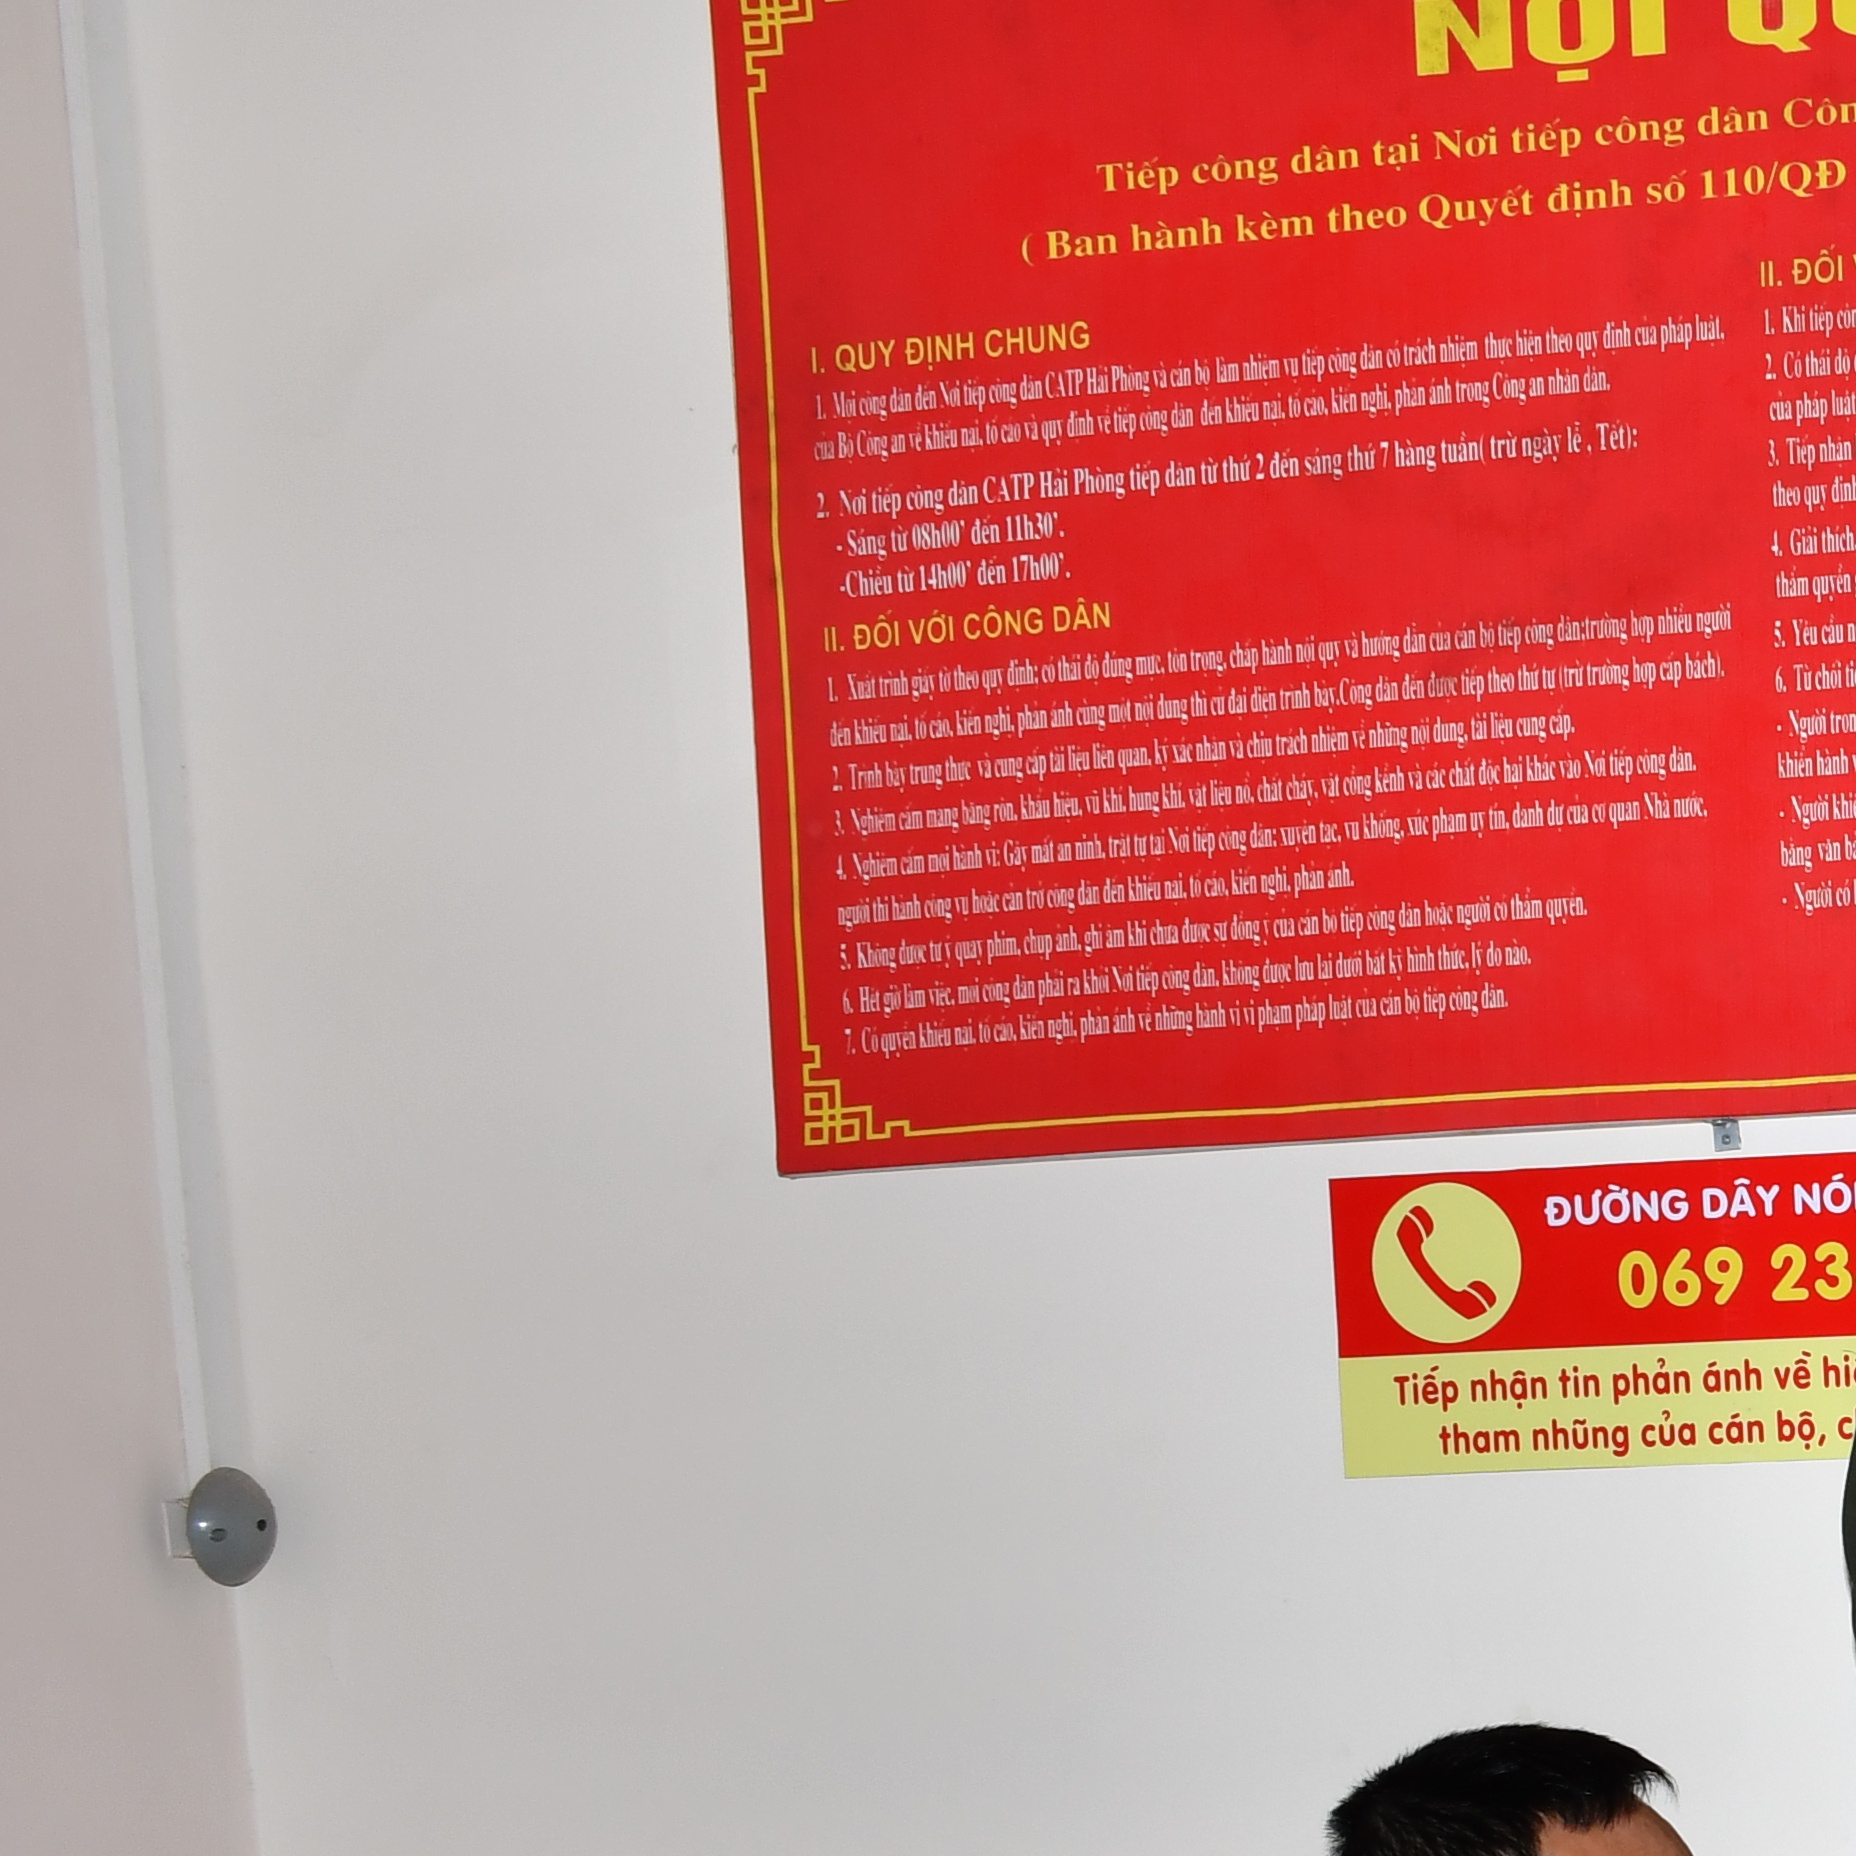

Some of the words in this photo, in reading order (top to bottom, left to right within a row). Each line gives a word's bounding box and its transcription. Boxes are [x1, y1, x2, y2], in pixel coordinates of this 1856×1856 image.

[1096, 156, 1179, 196] Tiếp
[1192, 154, 1279, 186] công
[1290, 144, 1359, 175] dân
[1372, 132, 1420, 172] tại
[1433, 125, 1498, 161] Nơi
[1511, 114, 1582, 158] tiếp
[1594, 115, 1685, 148] công
[1697, 105, 1769, 137] dân
[1046, 229, 1118, 260] Ban
[1131, 216, 1223, 252] hành
[1236, 210, 1314, 243] kèm
[1327, 202, 1407, 234] theo
[1418, 186, 1533, 230] Quyết
[1547, 178, 1633, 219] định
[1646, 170, 1686, 205] số
[1702, 158, 1847, 200] 110/QĐ
[1760, 260, 1783, 288] II.
[1791, 248, 1844, 286] ĐỐI
[811, 346, 825, 374] I.
[835, 338, 896, 374] QUY
[904, 331, 975, 371] ĐỊNH
[984, 319, 1090, 359] CHUNG
[823, 626, 845, 653] II.
[853, 613, 900, 651] ĐỐI
[907, 609, 955, 646] VỚI
[963, 603, 1044, 641] CÔNG
[1052, 596, 1111, 634] DÂN
[1544, 1183, 1689, 1228] ĐƯỜNG
[1702, 1176, 1780, 1220] DÂY
[1618, 1245, 1744, 1310] 069
[1393, 1365, 1459, 1413] Tiếp
[1470, 1367, 1548, 1410] nhận
[1558, 1364, 1601, 1400] tin
[1612, 1357, 1691, 1406] phản
[1702, 1357, 1763, 1394] ánh
[1773, 1350, 1812, 1391] về
[1438, 1421, 1521, 1456] tham
[1532, 1417, 1630, 1459] nhũng
[1640, 1409, 1697, 1449] của
[1708, 1412, 1765, 1446] cán
[1776, 1409, 1828, 1451] bộ,
